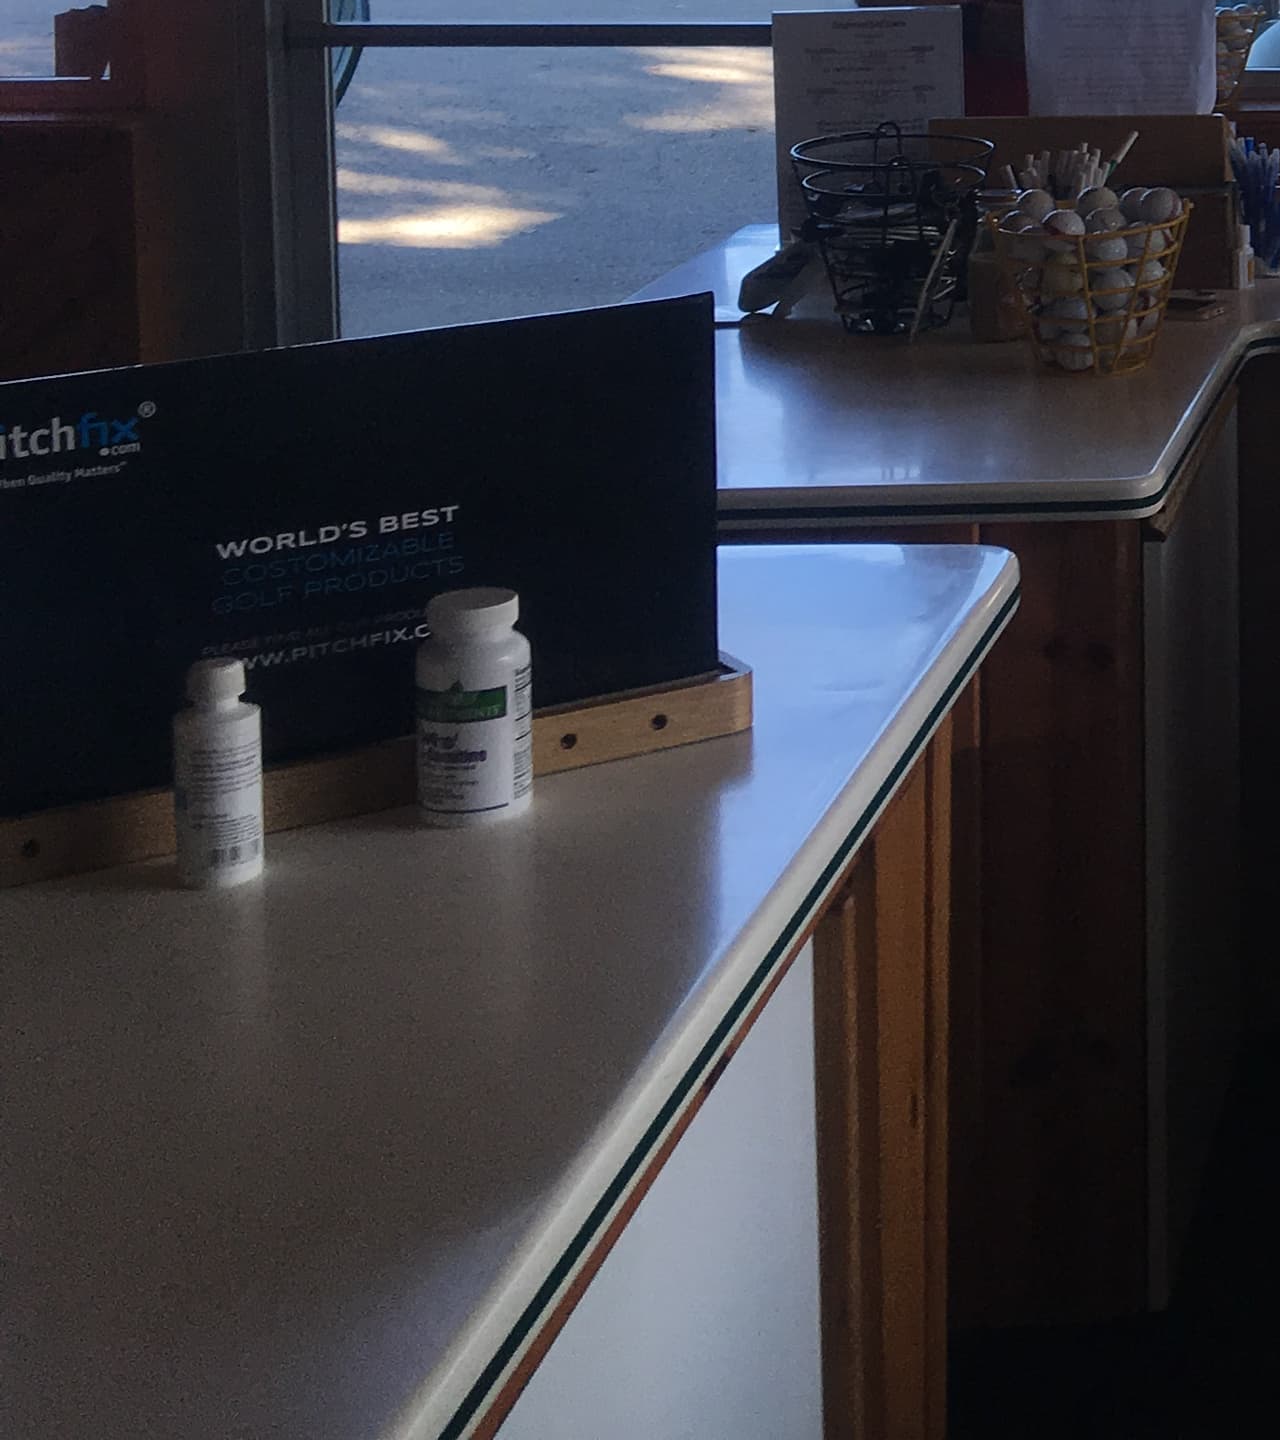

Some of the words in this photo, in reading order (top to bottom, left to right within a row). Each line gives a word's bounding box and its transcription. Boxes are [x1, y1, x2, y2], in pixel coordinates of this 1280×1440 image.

[0, 412, 140, 460] itchfix
[27, 470, 72, 487] Quality
[215, 520, 368, 560] WORLD'S
[378, 505, 460, 535] BEST
[303, 556, 466, 600] PRODUCTS
